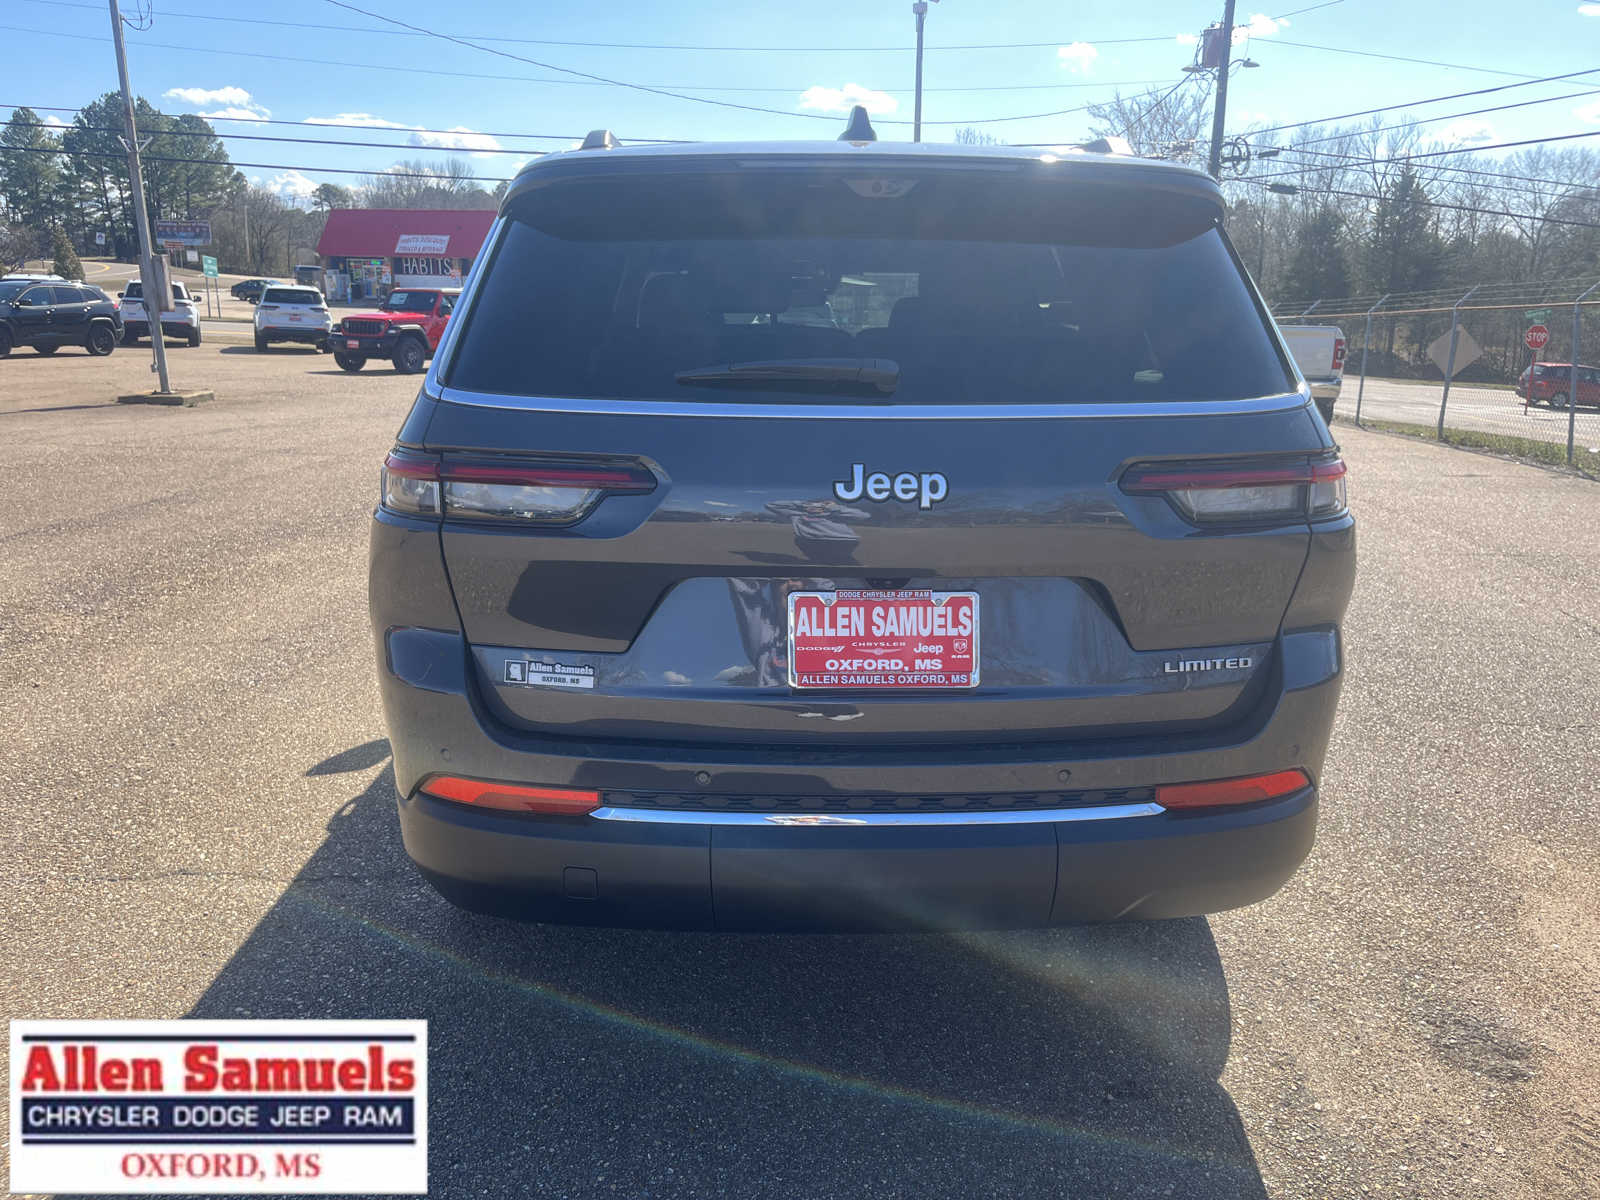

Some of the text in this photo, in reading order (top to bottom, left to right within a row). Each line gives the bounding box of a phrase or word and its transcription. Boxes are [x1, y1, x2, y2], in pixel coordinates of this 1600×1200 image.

[402, 257, 452, 275] HABITS
[1526, 332, 1548, 342] STOP
[834, 463, 948, 509] Jeep
[796, 606, 972, 637] ALLEN SAMUELS
[913, 642, 944, 655] Jeep
[529, 662, 594, 675] Allen Samuels
[825, 659, 943, 672] OXFORD, MS
[1164, 657, 1252, 673] LIMITED
[801, 674, 968, 685] ALLEN SAMUELS OXFORD, MS
